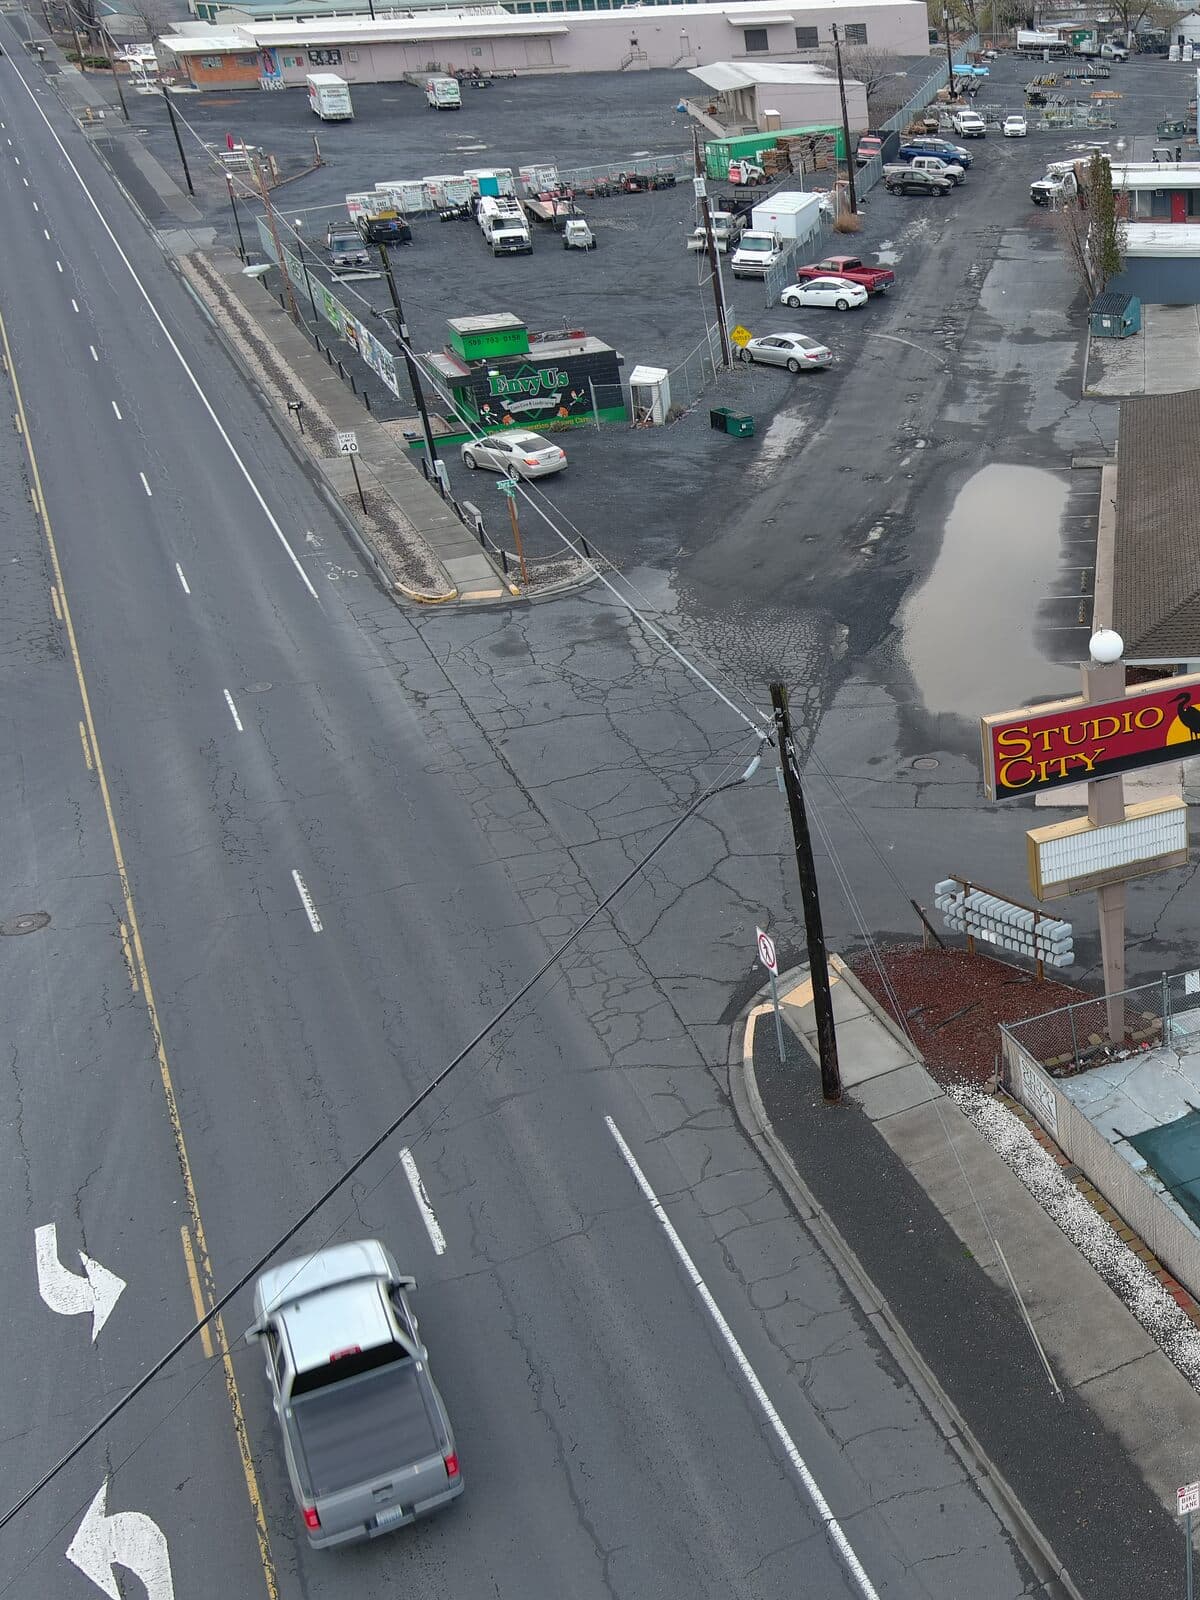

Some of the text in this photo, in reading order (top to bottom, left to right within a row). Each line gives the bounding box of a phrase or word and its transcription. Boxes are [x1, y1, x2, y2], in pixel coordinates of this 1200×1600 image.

[487, 368, 569, 396] EnvyUs
[342, 443, 358, 451] 40
[997, 706, 1165, 760] STUDIO
[1000, 748, 1106, 789] CITY
[1181, 1494, 1197, 1504] BIKE
[1181, 1500, 1197, 1511] LANE
